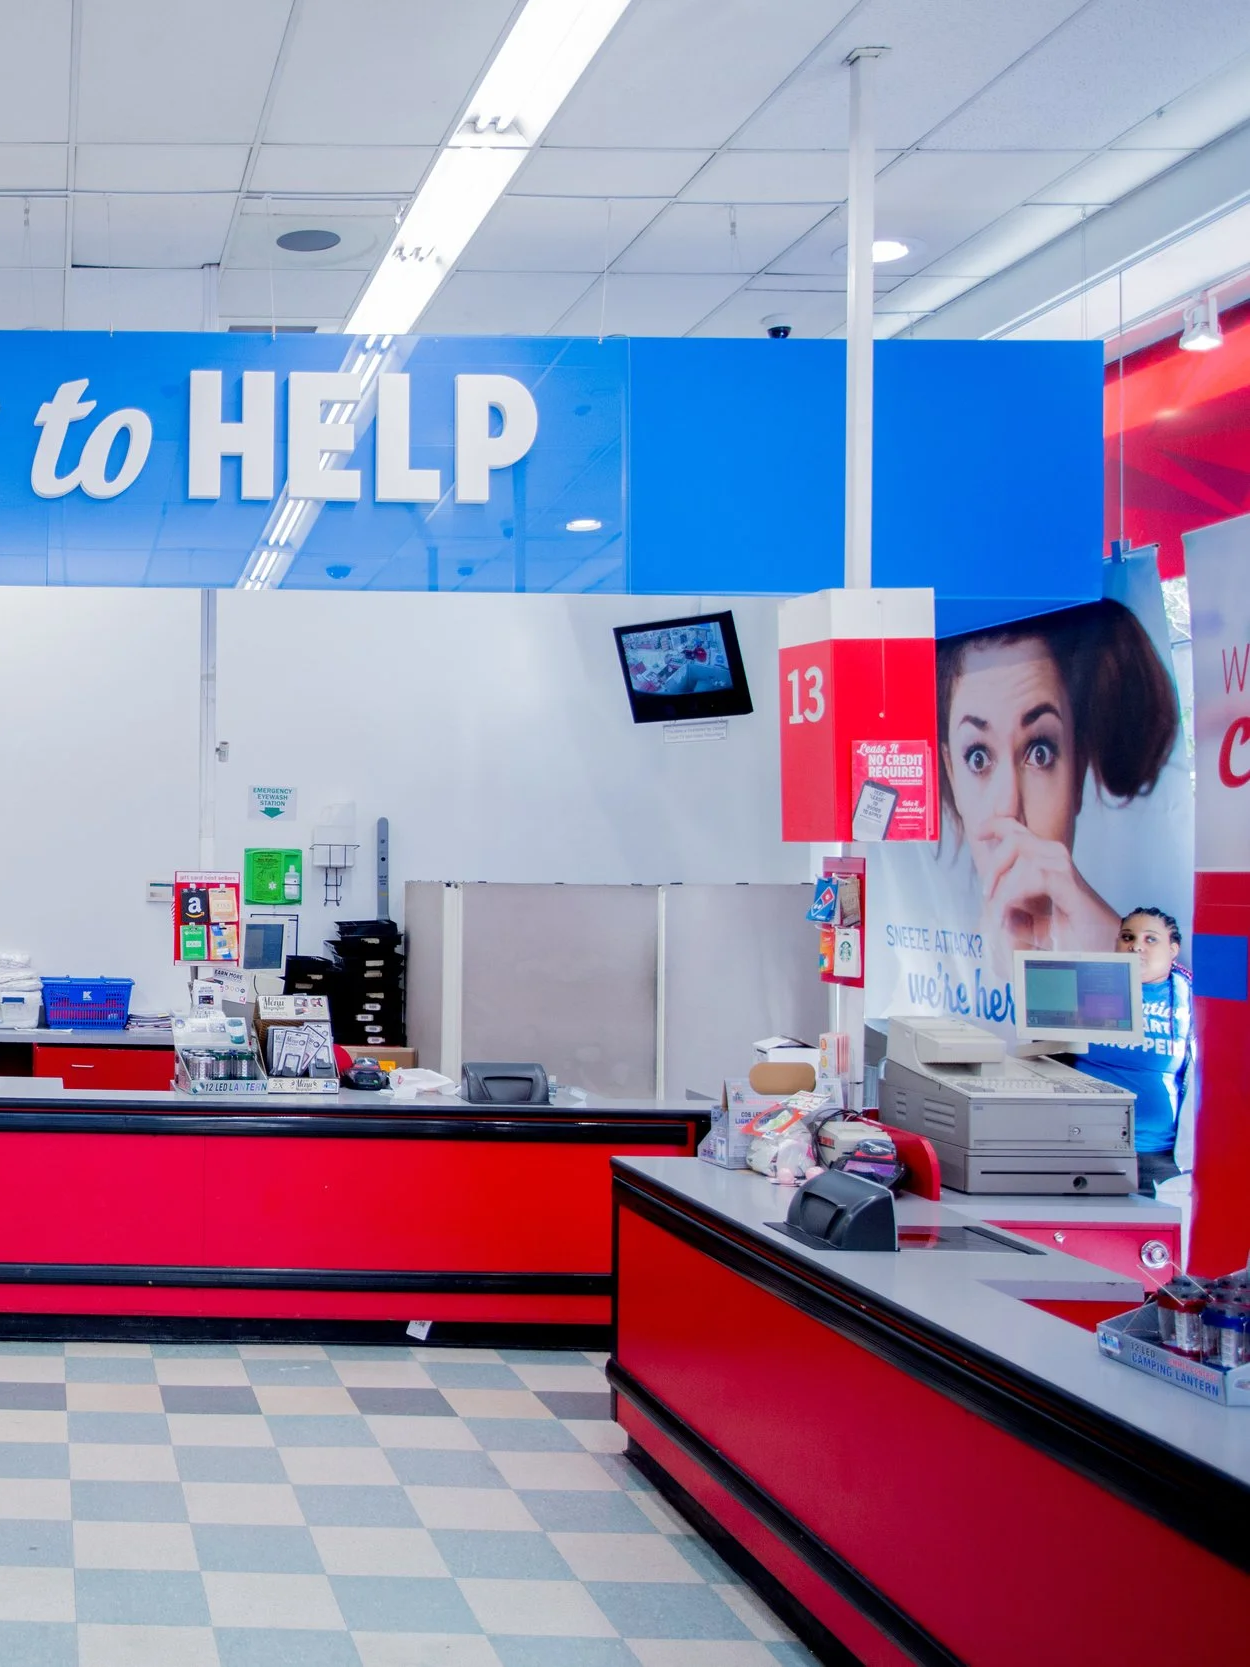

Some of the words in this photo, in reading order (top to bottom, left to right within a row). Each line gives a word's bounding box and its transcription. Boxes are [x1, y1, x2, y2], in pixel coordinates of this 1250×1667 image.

[30, 378, 152, 500] to
[188, 370, 538, 504] HELP
[787, 665, 825, 724] 13
[856, 743, 887, 757] Lease
[888, 743, 899, 753] It
[868, 754, 884, 766] NO
[886, 754, 923, 766] CREDIT
[868, 766, 923, 778] REQUIRED
[253, 787, 292, 795] EMERGENCY
[188, 897, 202, 913] a
[886, 924, 930, 951] SNEEZE
[934, 930, 983, 958] ATTACK?
[214, 969, 228, 977] EARN
[229, 972, 243, 980] MORE
[907, 961, 970, 1015] we're
[230, 1083, 267, 1092] LANTERN
[1141, 1346, 1156, 1358] LED
[1131, 1352, 1173, 1378] CAMPING
[1175, 1371, 1220, 1397] LANTERN
